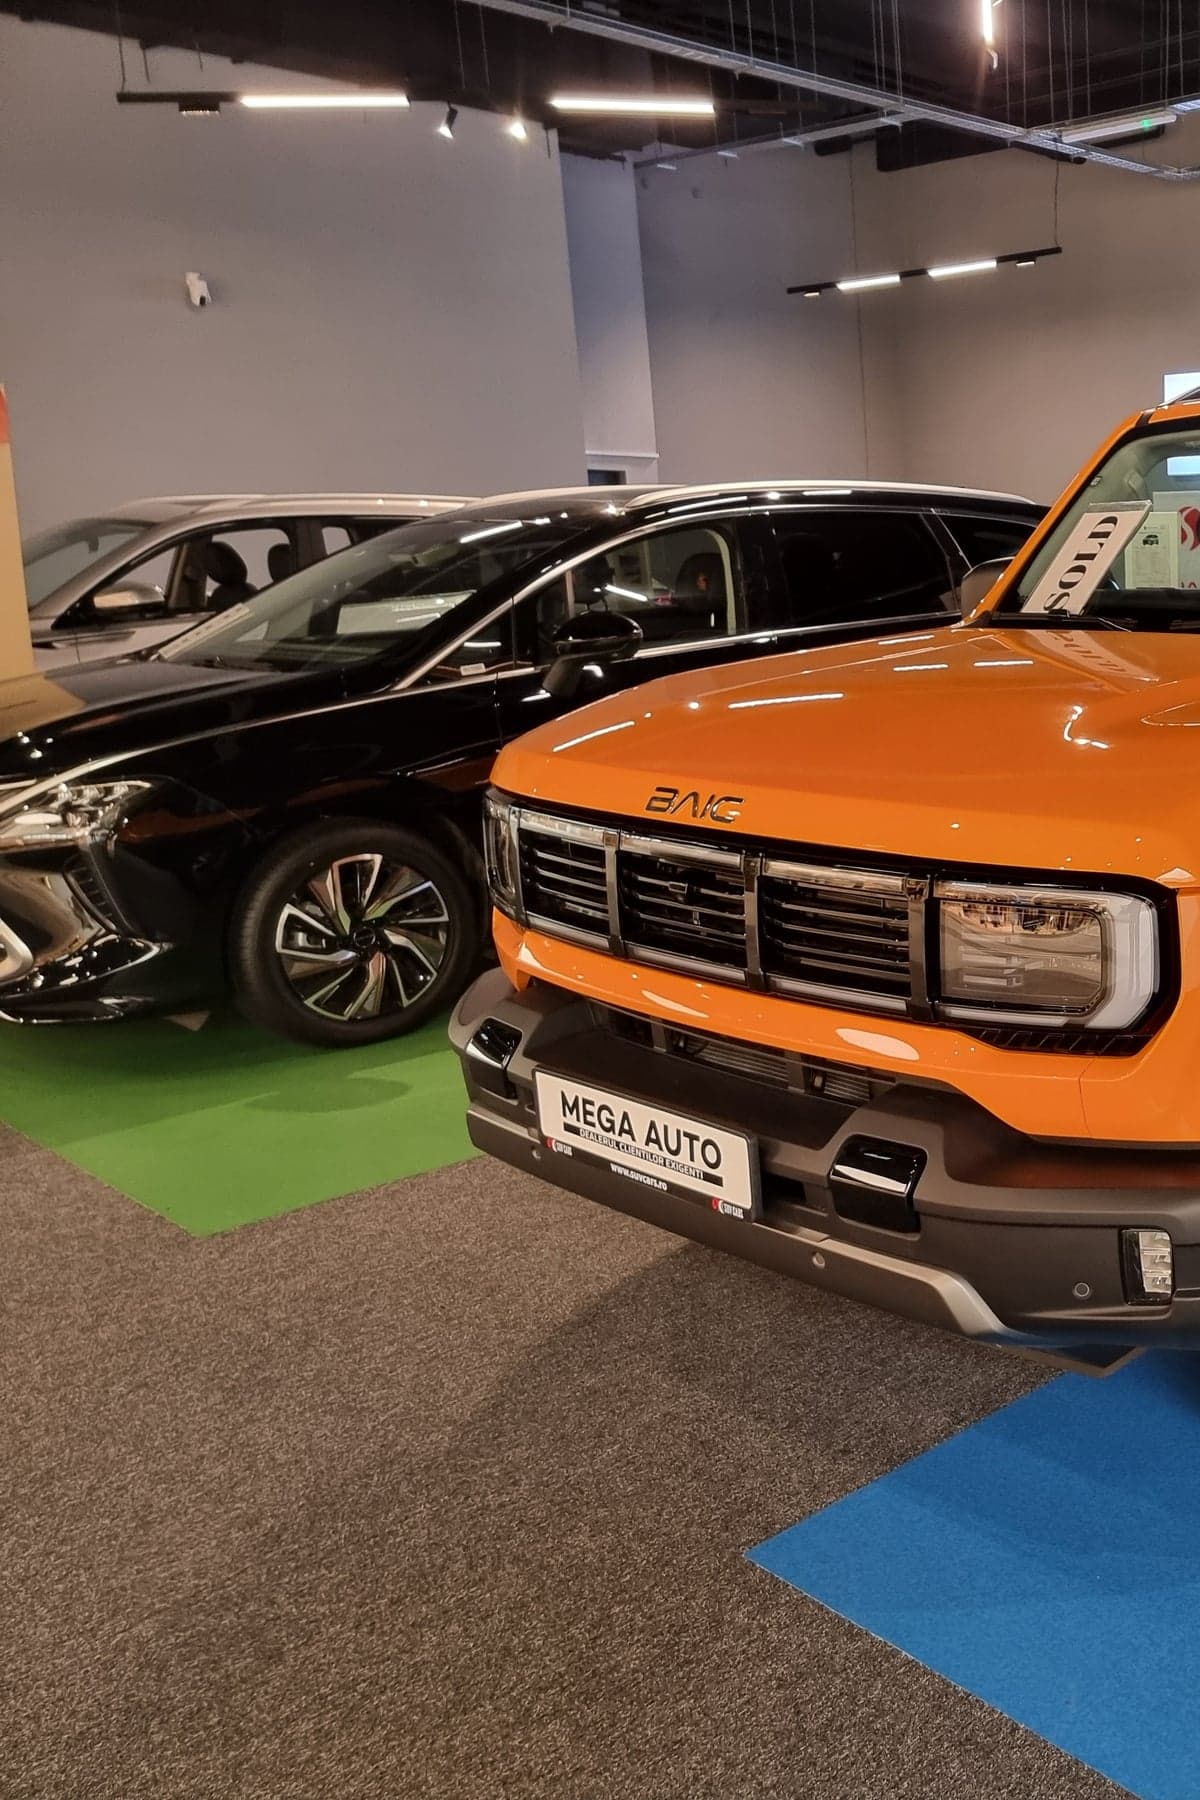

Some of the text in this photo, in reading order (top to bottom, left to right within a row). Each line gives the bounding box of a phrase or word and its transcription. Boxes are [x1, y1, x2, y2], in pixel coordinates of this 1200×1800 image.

[1043, 515, 1118, 611] SOLD
[645, 786, 745, 824] BAIC
[560, 1090, 722, 1170] MEGA AUTO
[579, 1128, 704, 1180] DEALERUL CLIENTILOR EXIGENTI
[609, 1162, 668, 1191] www.suvcars.ro
